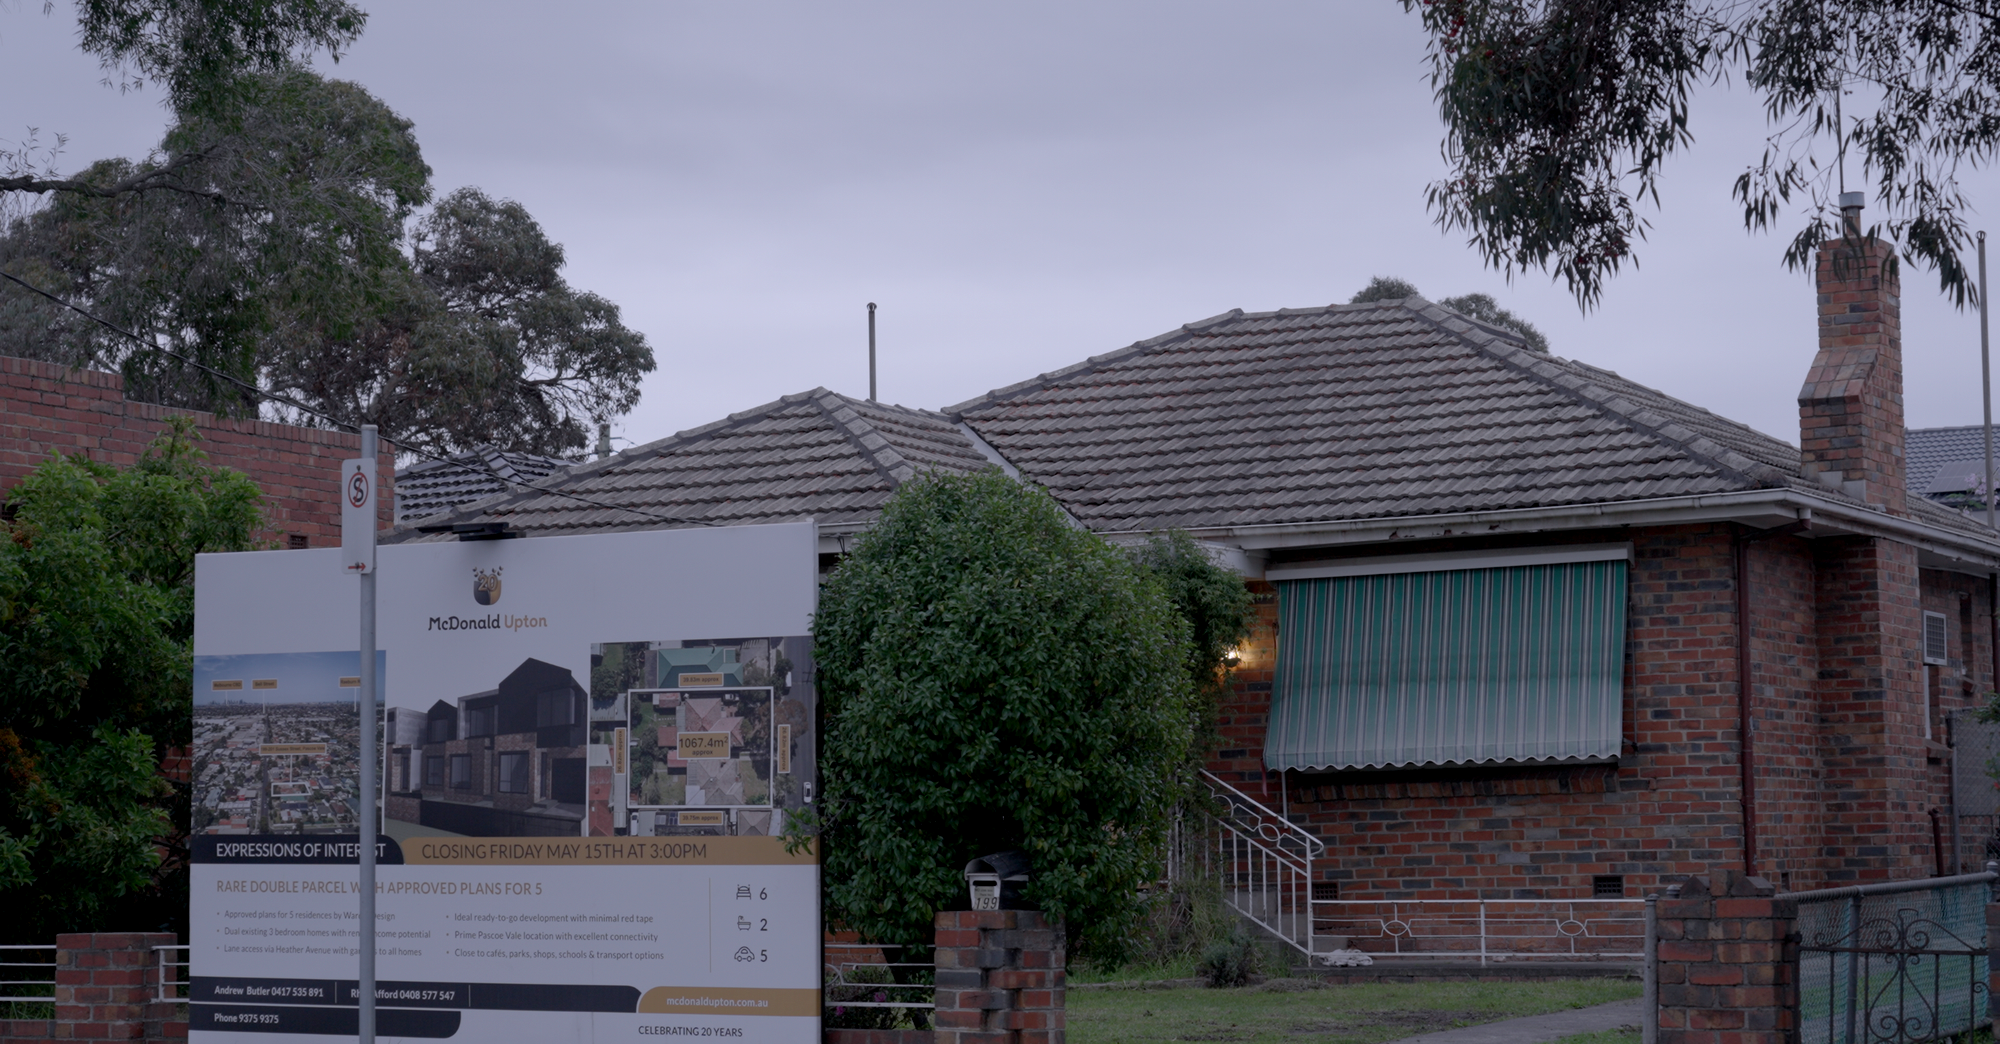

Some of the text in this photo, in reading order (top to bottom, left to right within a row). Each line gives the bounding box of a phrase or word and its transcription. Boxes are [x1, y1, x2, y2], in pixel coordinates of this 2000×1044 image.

[353, 477, 364, 503] S
[477, 573, 499, 592] 20
[428, 614, 547, 632] McDonald Upton
[217, 843, 301, 857] EXPRESSIONS
[303, 843, 321, 857] OF
[422, 843, 706, 859] CLOSING FRIDAY MAY 15TH AT 3:00PM
[217, 880, 542, 895] RARE DOUBLE PARCEL WH APPROVED PLANS FOR 5
[760, 888, 767, 900] 6
[224, 910, 257, 919] Approved
[258, 911, 276, 919] plans
[295, 911, 332, 919] residences
[334, 912, 342, 920] by
[343, 910, 360, 920] War
[374, 911, 395, 921] esign
[455, 913, 653, 924] Ideal ready-to-go development with minimal red tape
[760, 918, 767, 931] 2
[977, 914, 997, 932] 199
[225, 927, 240, 935] Dual
[241, 928, 267, 937] existing
[269, 928, 273, 936] 3
[275, 928, 305, 936] bedroom
[348, 928, 360, 938] ren
[398, 930, 430, 939] potential
[455, 930, 658, 942] Prime Pascoe Vale location with excellent connectivity
[264, 945, 274, 953] via
[305, 946, 331, 954] Avenue
[378, 948, 387, 956] to
[398, 948, 422, 956] homes
[455, 948, 474, 957] Close
[486, 948, 508, 959] cafés,
[509, 950, 532, 959] parks,
[533, 950, 557, 959] shops,
[559, 950, 587, 958] schools
[589, 950, 594, 958] &
[597, 951, 632, 960] transport
[635, 951, 664, 961] options
[761, 950, 767, 962] 5
[214, 986, 323, 997] Andrew Butler 0417 535 891
[400, 990, 420, 999] 0408
[422, 991, 437, 999] 577
[440, 991, 455, 1000] 547
[667, 996, 768, 1008] mcdonaldupton.com.au
[214, 1013, 279, 1023] Phone 9375 9375
[638, 1026, 742, 1037] CELEBRATING 20 YEARS
